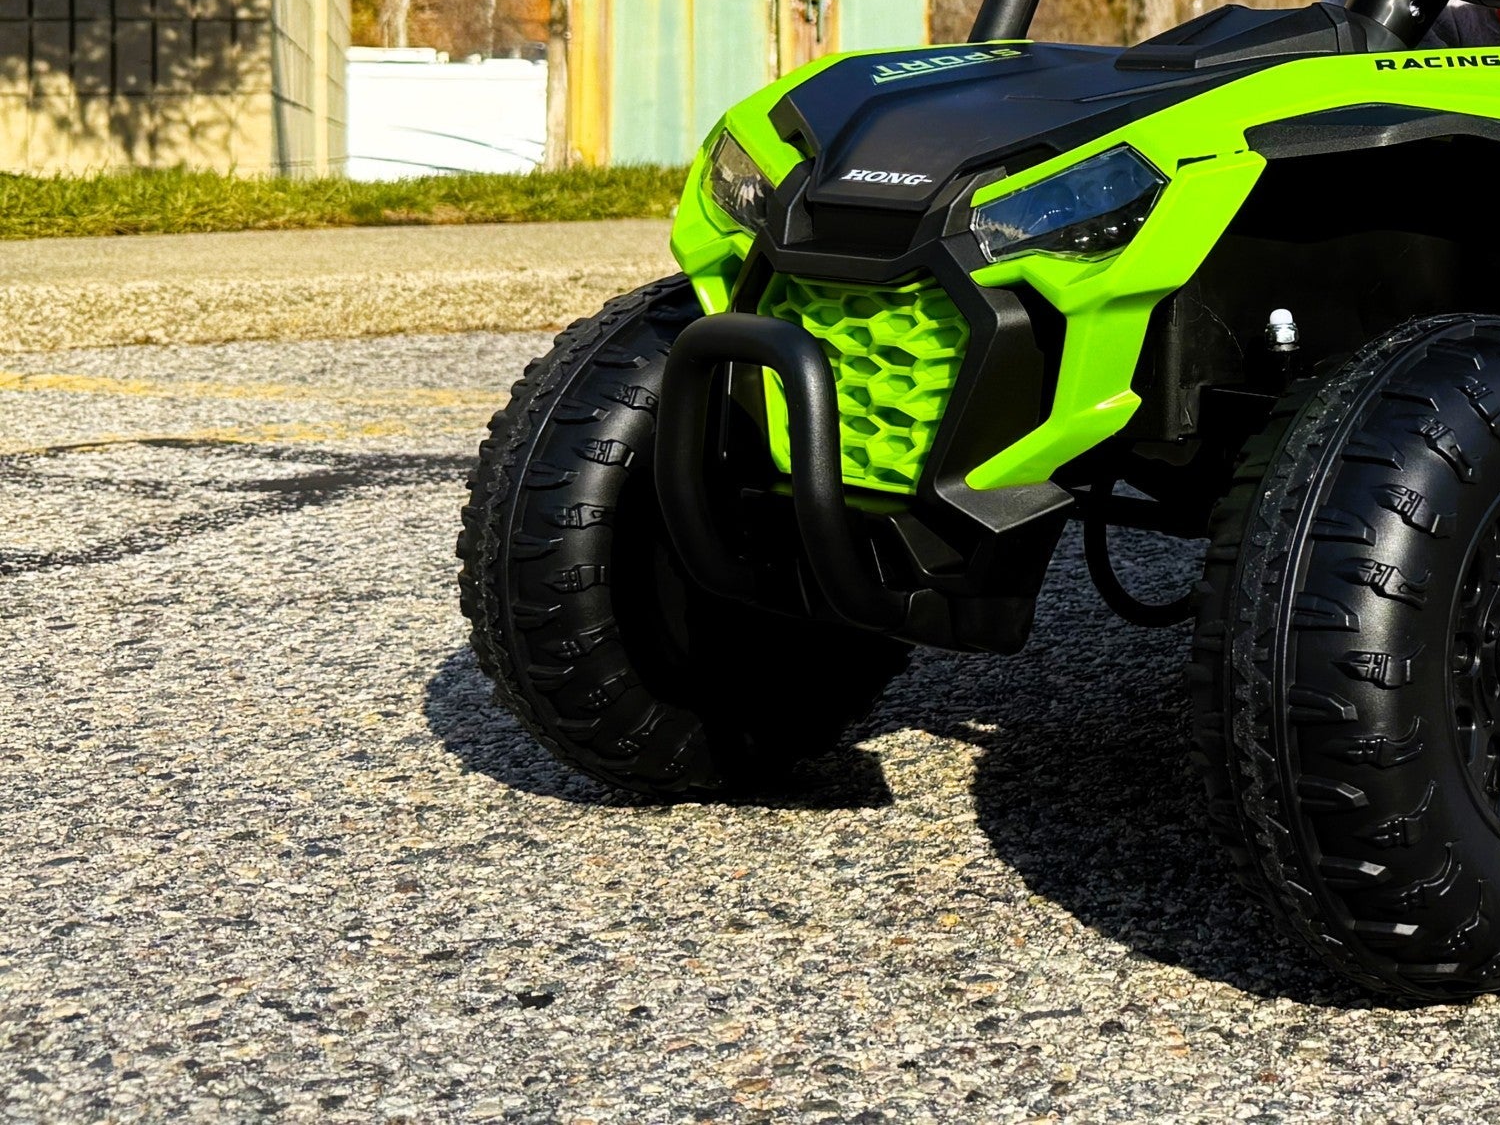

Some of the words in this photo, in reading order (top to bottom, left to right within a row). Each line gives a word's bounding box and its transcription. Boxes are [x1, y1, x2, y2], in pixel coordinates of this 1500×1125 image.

[874, 47, 1022, 77] SPORT
[1374, 55, 1500, 71] RACING
[840, 168, 933, 185] HONG-
